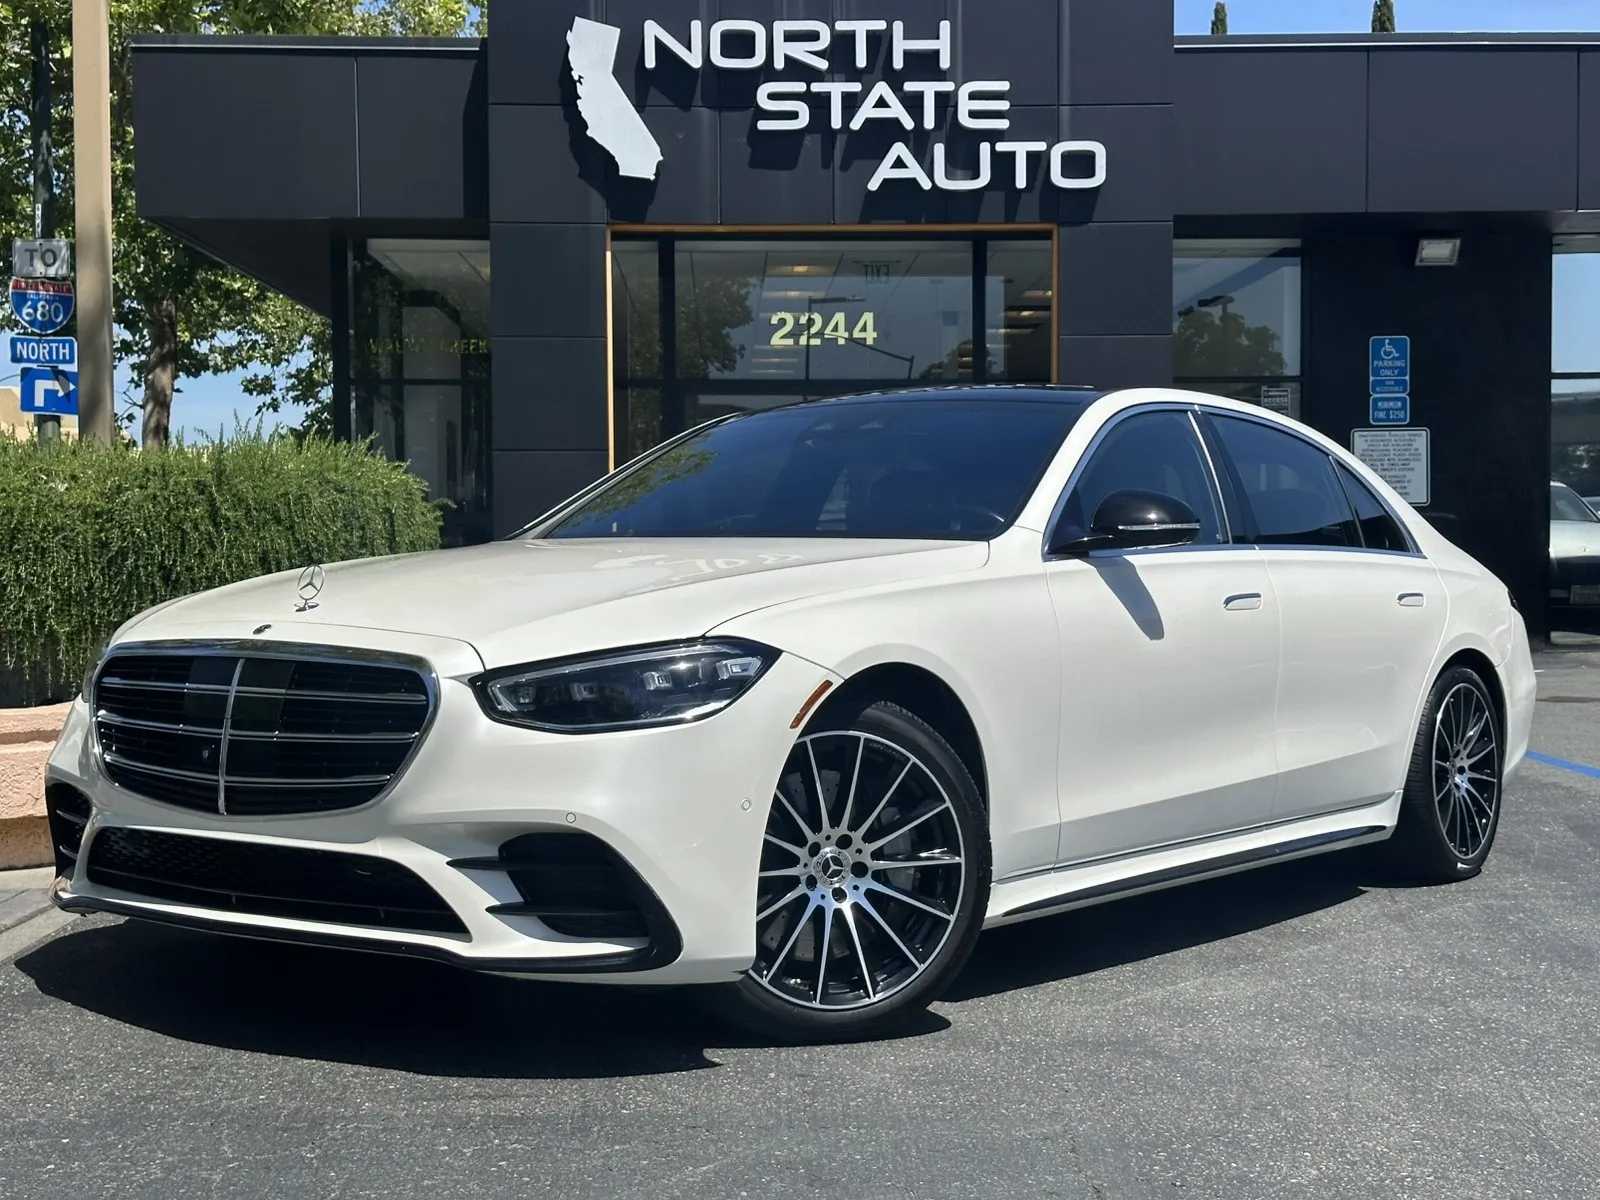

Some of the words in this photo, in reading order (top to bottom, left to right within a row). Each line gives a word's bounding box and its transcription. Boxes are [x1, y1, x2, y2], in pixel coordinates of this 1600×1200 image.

[643, 19, 951, 71] NORTH
[756, 80, 1011, 131] STATE
[867, 140, 1107, 191] AUTO
[24, 248, 58, 268] TO
[22, 300, 64, 323] 680
[770, 311, 878, 346] 2244
[16, 341, 70, 361] NORTH
[1373, 360, 1406, 368] PARKING
[1379, 368, 1399, 376] ONLY
[1374, 410, 1387, 419] FINE
[1389, 410, 1405, 419] $250
[1377, 401, 1402, 409] MINIMUM
